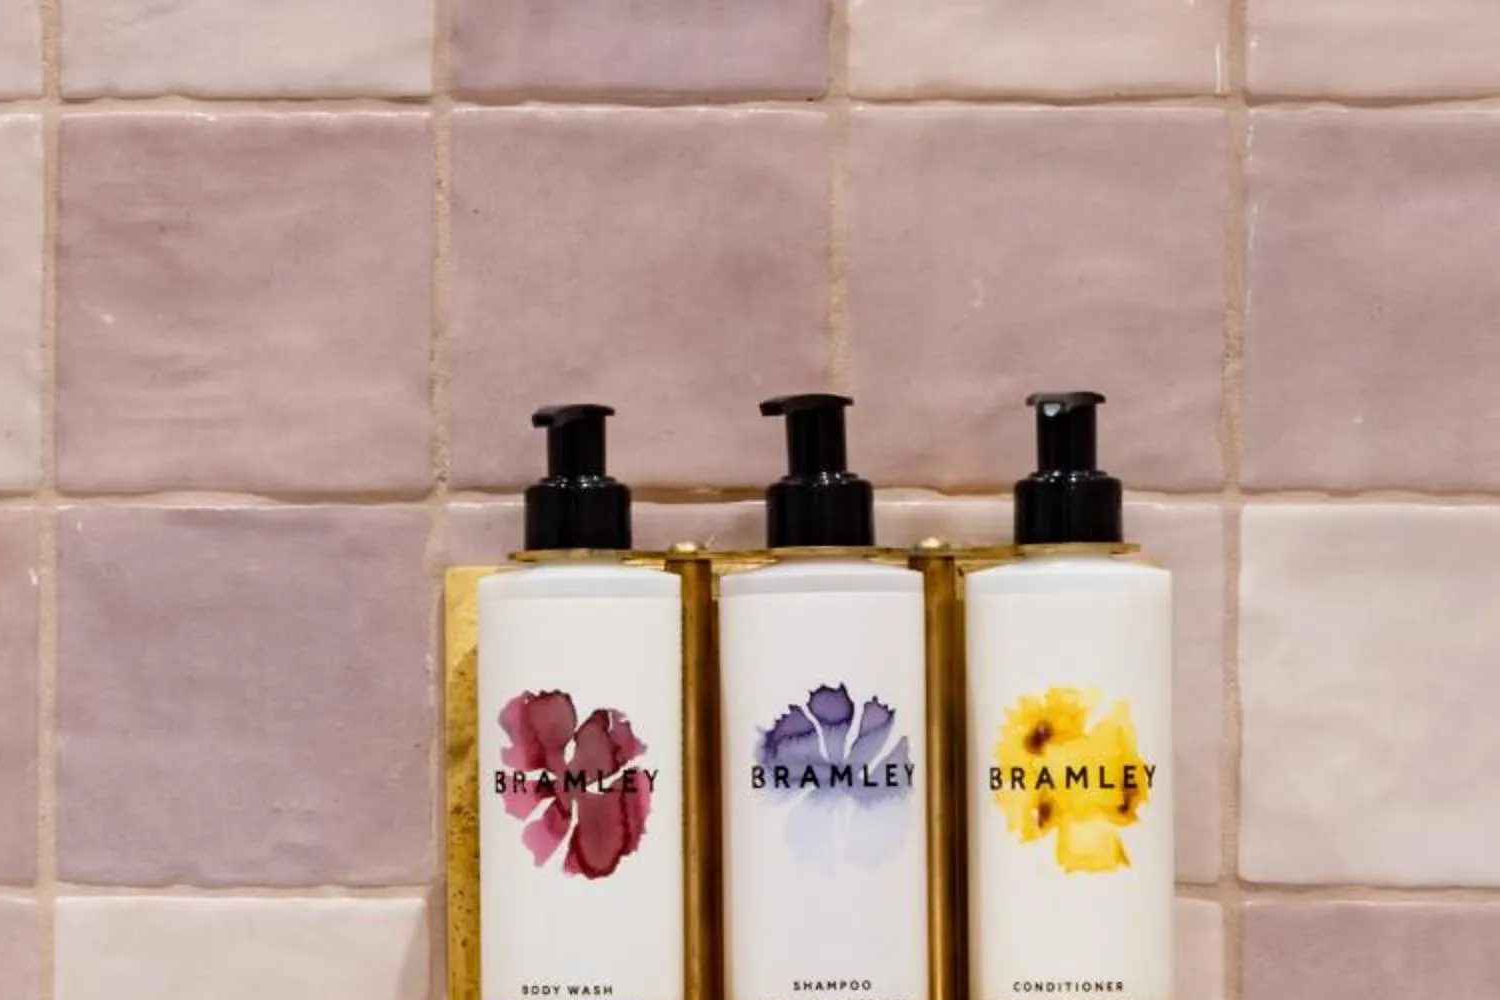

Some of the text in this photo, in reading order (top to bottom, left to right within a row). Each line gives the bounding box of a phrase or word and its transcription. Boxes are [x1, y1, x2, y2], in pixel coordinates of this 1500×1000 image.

[494, 769, 659, 795] BRAMLEY
[751, 763, 916, 789] BRAMLEY
[989, 764, 1157, 790] BRAMLEY
[521, 985, 614, 995] BODY WASH
[793, 980, 873, 991] SHAMPOO
[1012, 981, 1124, 993] CONDITIONER
